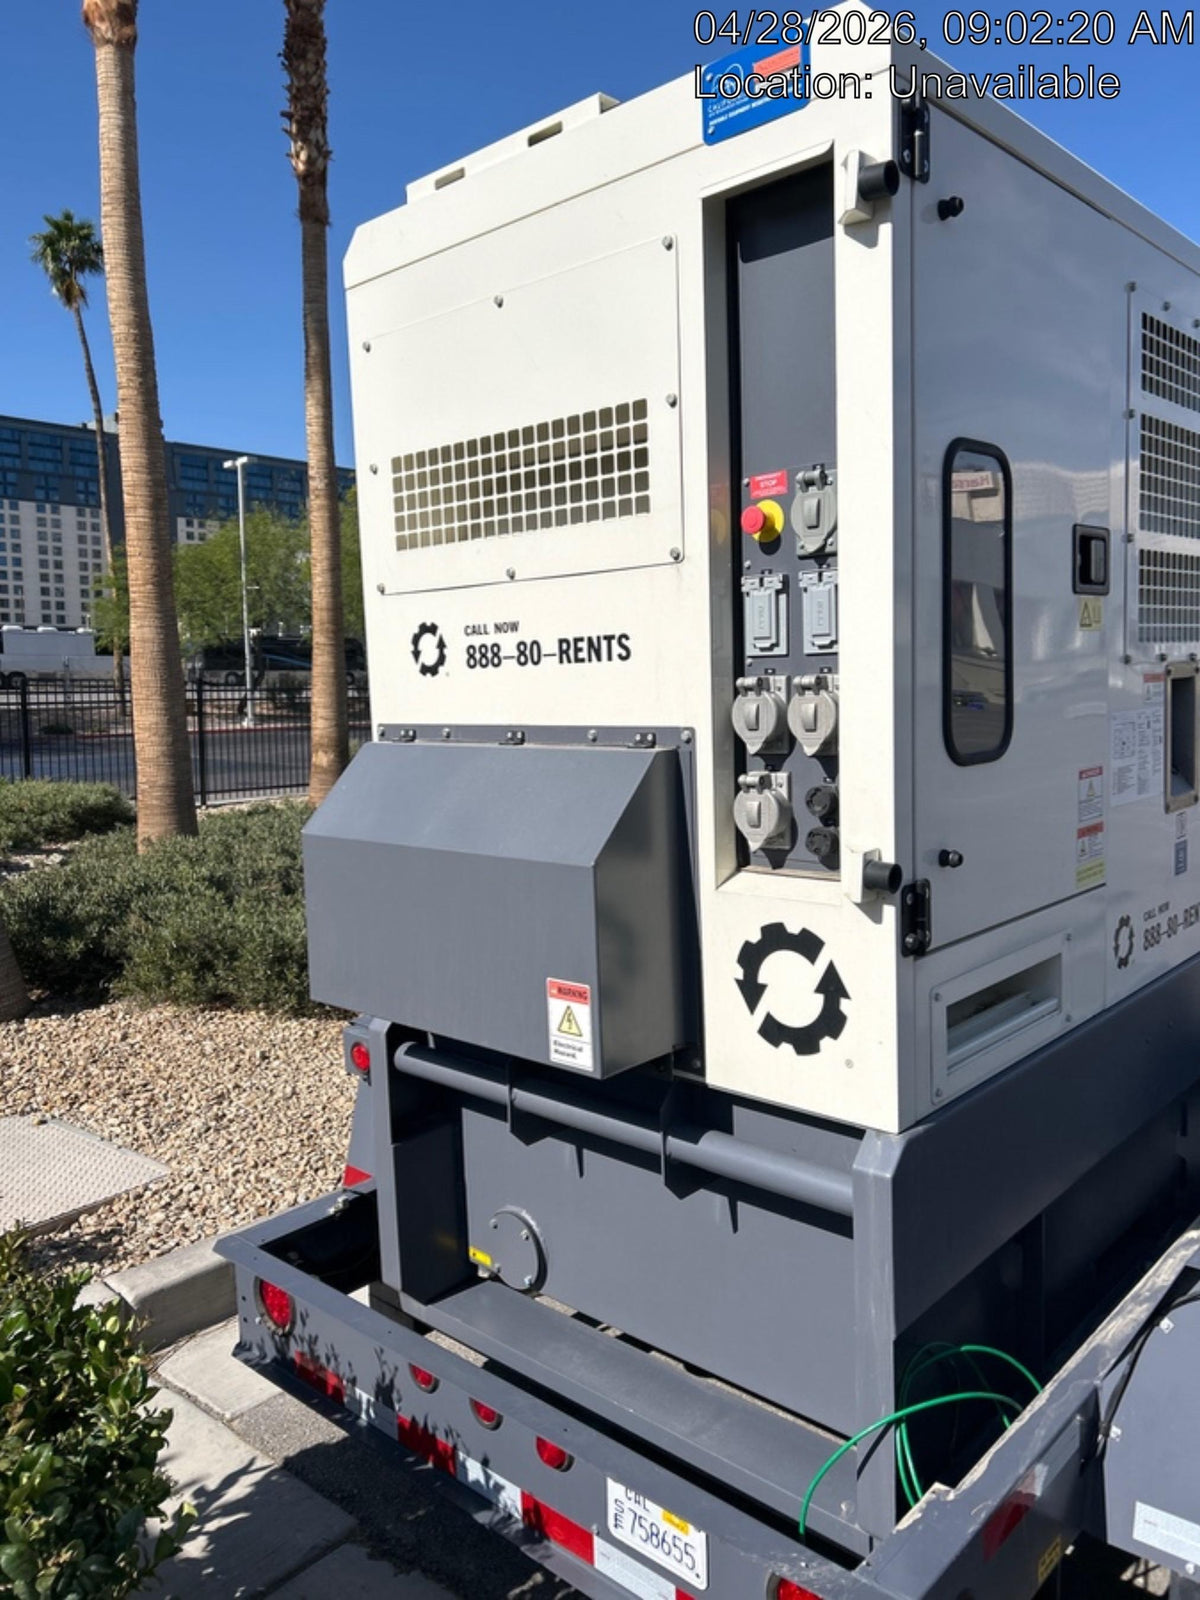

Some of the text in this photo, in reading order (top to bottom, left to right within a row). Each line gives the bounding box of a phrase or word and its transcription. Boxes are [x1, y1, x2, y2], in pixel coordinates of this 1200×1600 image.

[464, 620, 519, 637] CALL NOW
[627, 1507, 696, 1572] 758655
